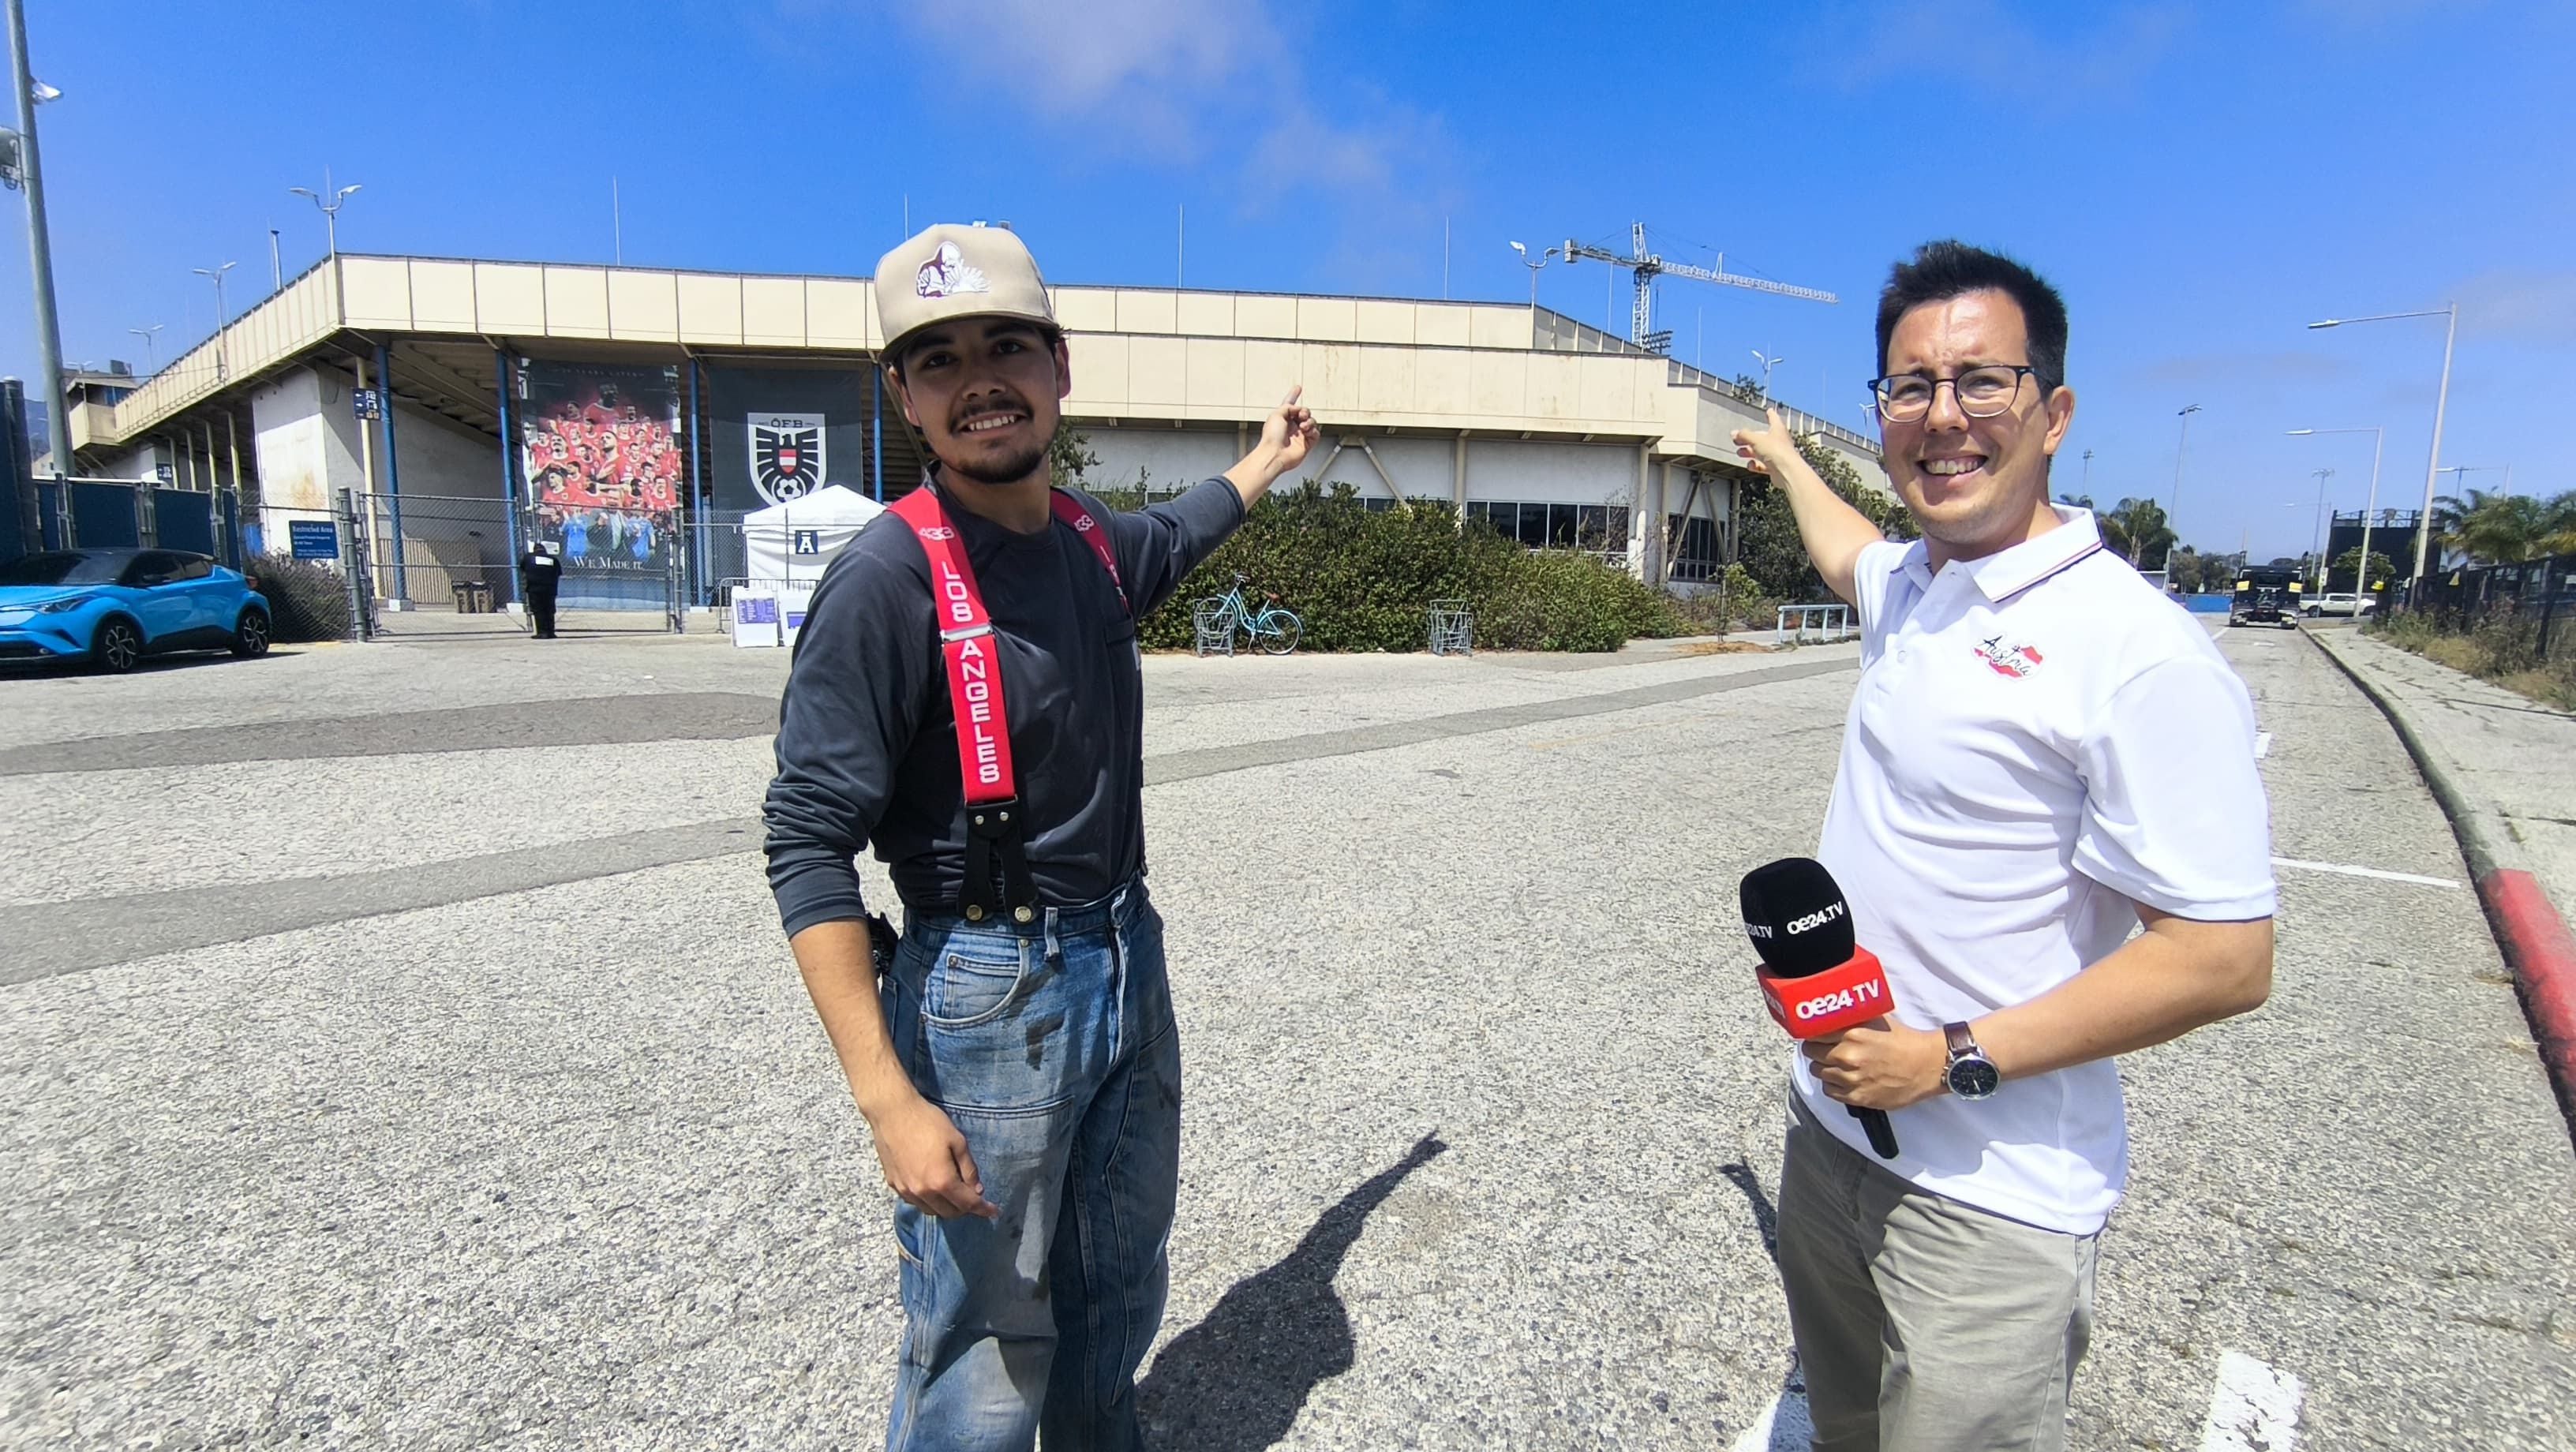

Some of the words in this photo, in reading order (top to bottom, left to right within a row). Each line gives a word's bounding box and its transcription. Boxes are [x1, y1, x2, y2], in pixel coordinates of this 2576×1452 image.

[941, 560, 974, 622] LOS
[960, 638, 1000, 784] ANGELES
[1786, 900, 1844, 935] oe24.TV
